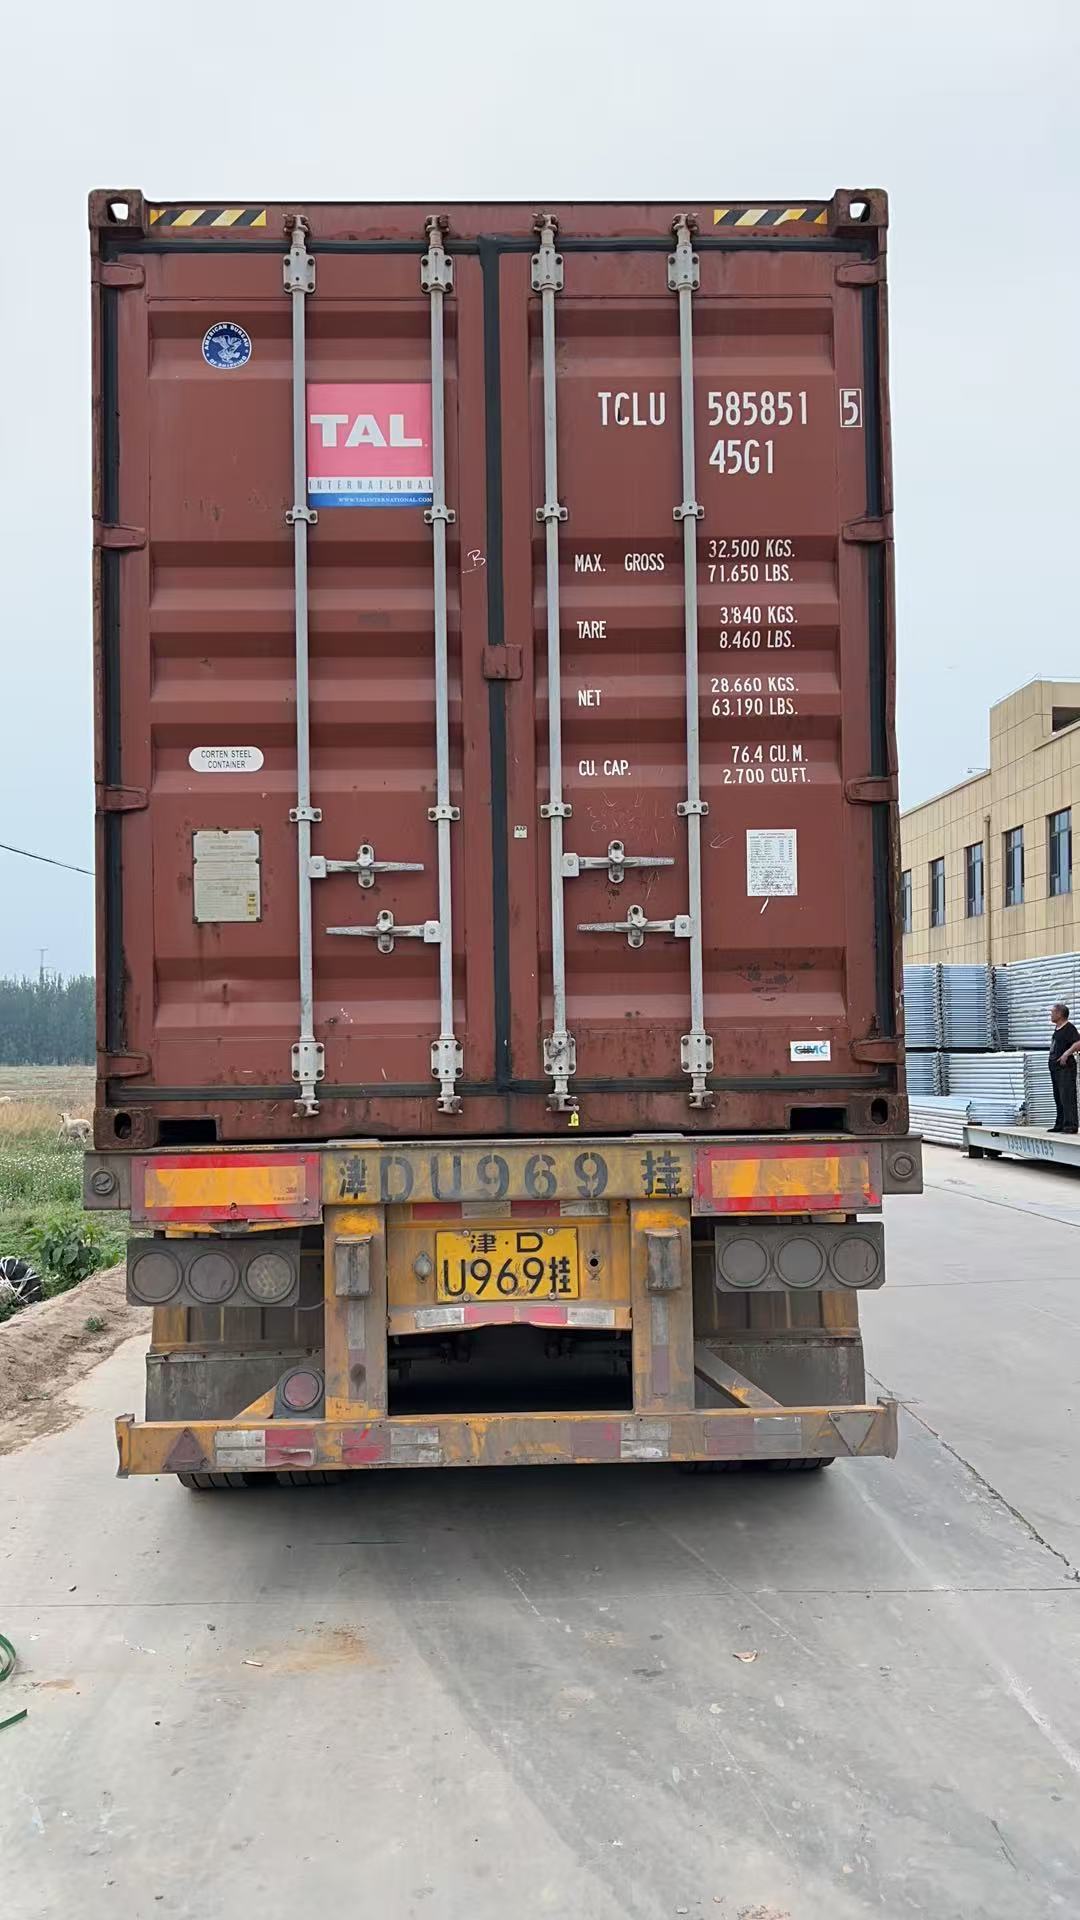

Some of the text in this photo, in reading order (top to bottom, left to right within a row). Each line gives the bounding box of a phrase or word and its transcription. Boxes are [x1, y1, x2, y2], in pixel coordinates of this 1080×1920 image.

[204, 324, 249, 350] AMERICAN BUREAU
[597, 390, 859, 426] TCLU 585851 5
[708, 439, 774, 475] 45G1
[765, 539, 796, 558] KGS.
[574, 553, 665, 573] MAX. GROSS
[765, 564, 794, 582] LBS.
[767, 605, 798, 624] KGS.
[576, 620, 607, 639] TARE
[767, 630, 796, 648] LBS.
[768, 676, 799, 692] KGS.
[577, 689, 602, 707] NET
[769, 697, 799, 716] LBS.
[200, 749, 252, 759] CORTEN STEEL
[731, 745, 763, 763] 76.4
[207, 760, 246, 769] CONTAINER
[578, 760, 632, 777] CU. CAP.
[442, 1256, 572, 1297] U969挂
